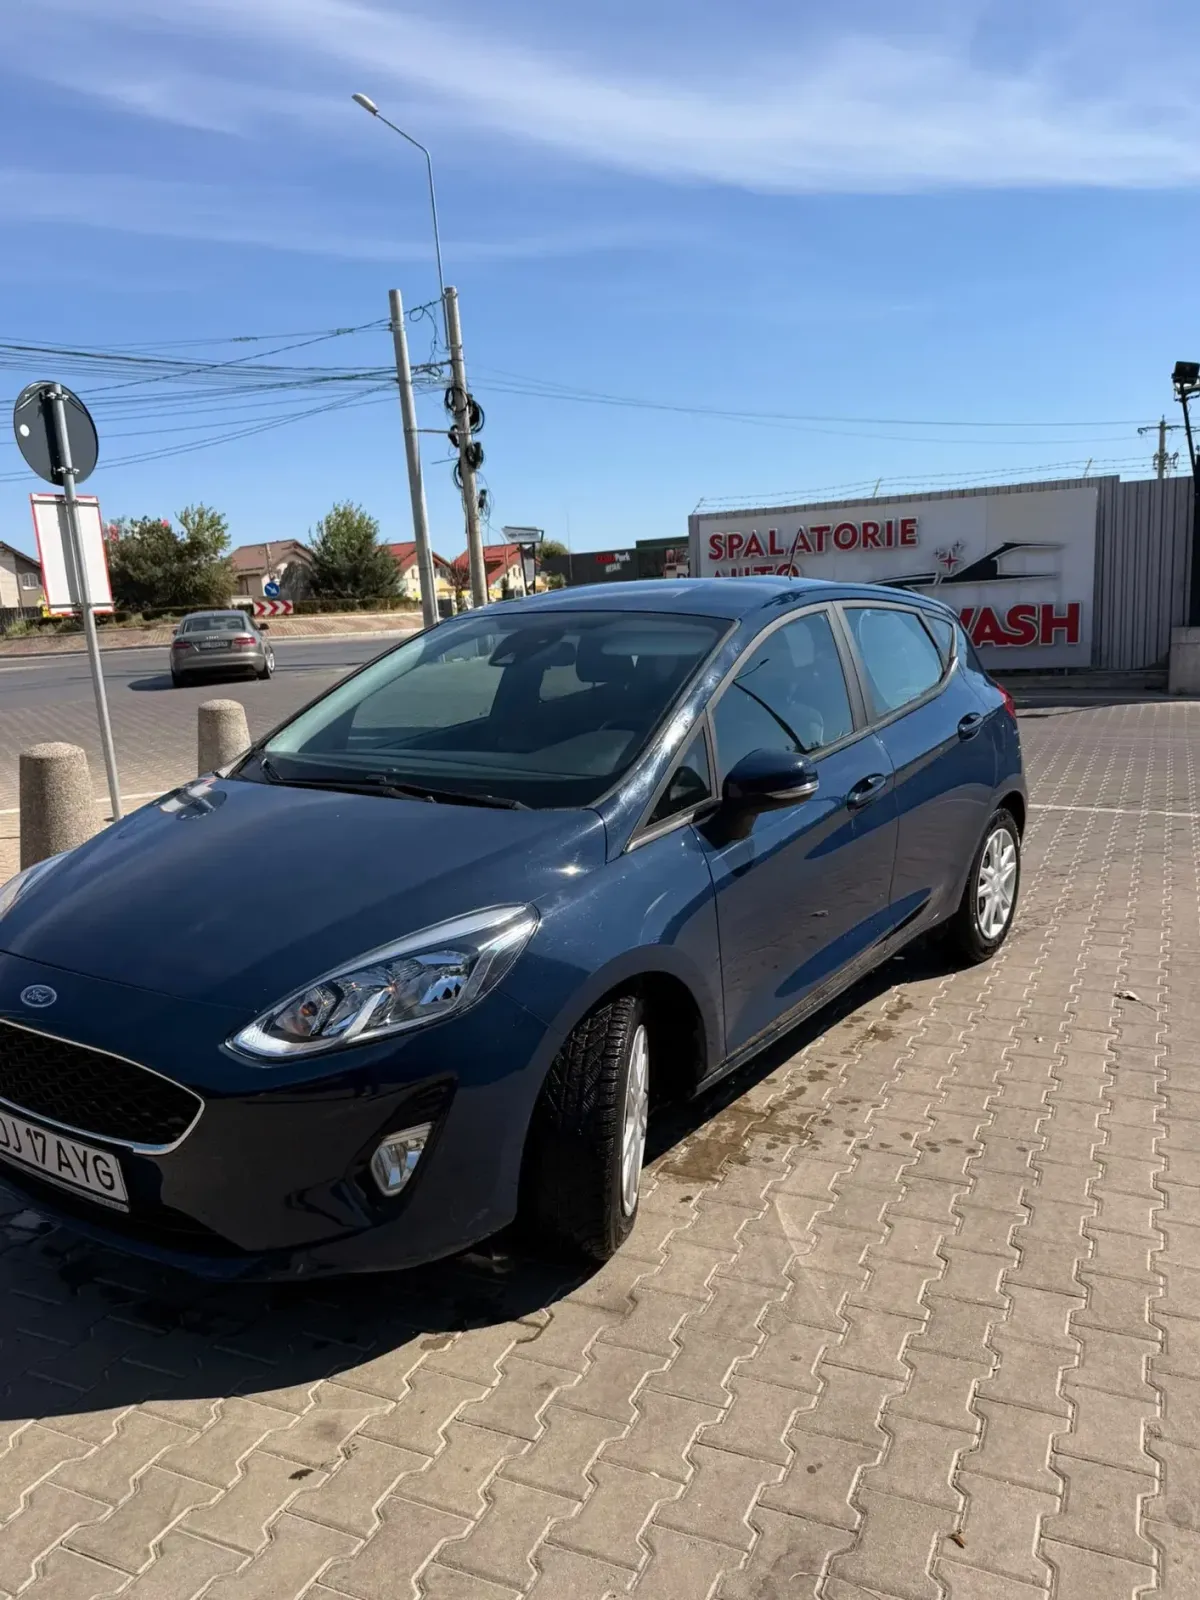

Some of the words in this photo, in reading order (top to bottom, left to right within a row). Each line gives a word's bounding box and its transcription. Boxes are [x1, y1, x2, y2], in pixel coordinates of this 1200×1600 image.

[707, 516, 919, 561] SPALATORIE
[25, 1127, 47, 1165] 17
[56, 1140, 116, 1191] AYG
